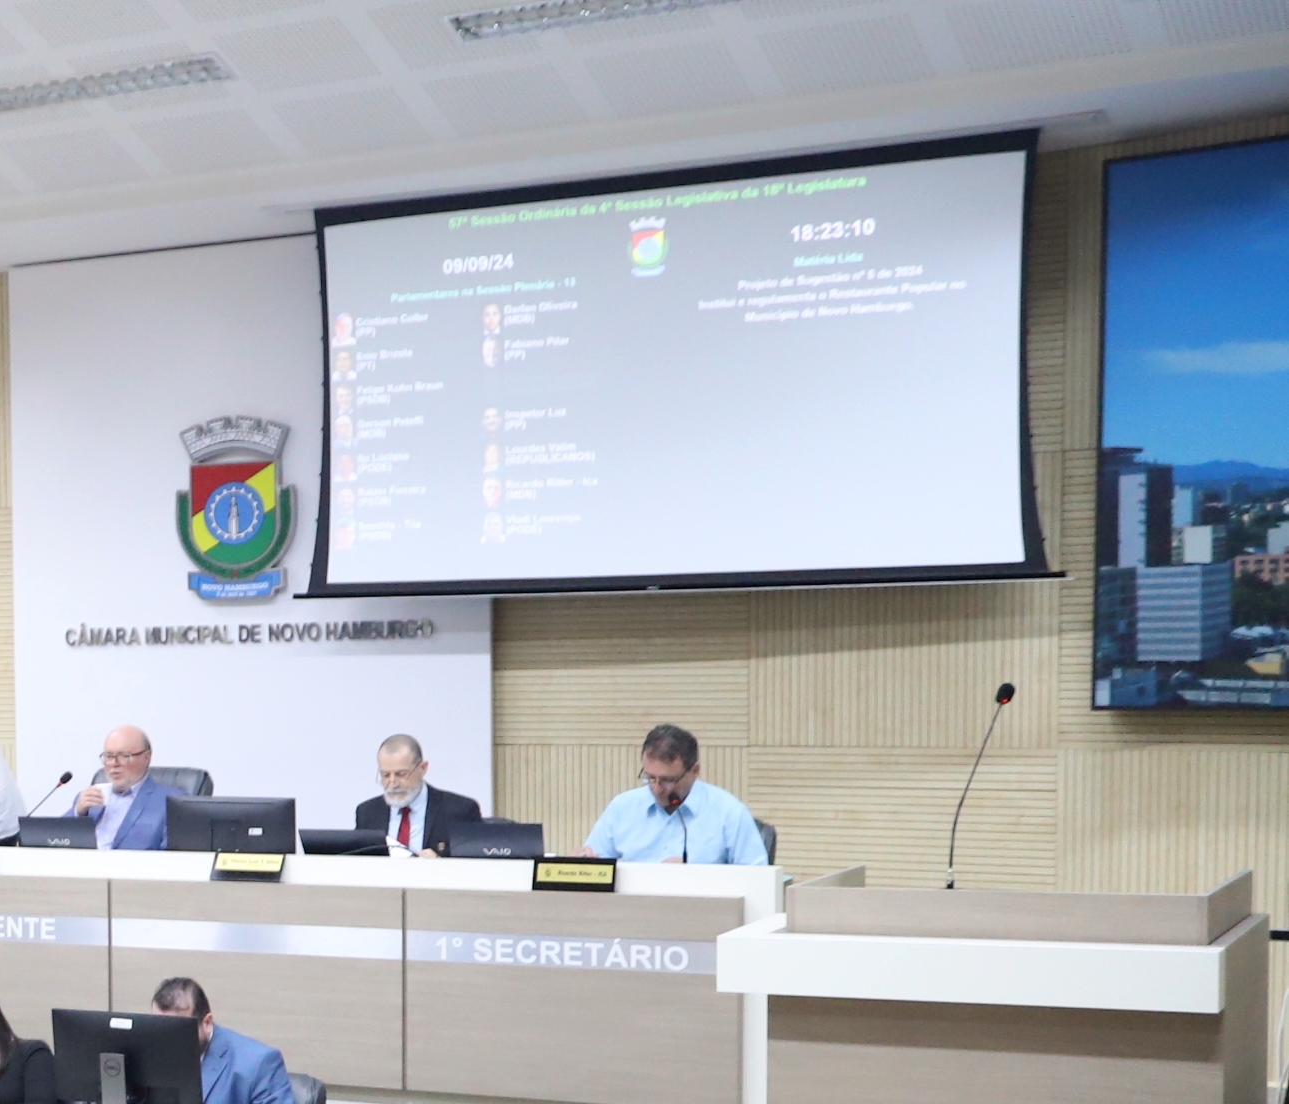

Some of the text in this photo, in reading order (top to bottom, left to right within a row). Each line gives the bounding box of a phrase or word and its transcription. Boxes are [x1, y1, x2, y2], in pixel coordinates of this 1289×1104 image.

[790, 217, 876, 243] 18:23:10
[442, 252, 515, 275] 09/09/24
[65, 617, 436, 648] CÂMARA MUNICIPAL DE NOVO HAMBURGO
[482, 847, 511, 856] VAIO
[435, 936, 690, 971] 1º SECRETÁRIO
